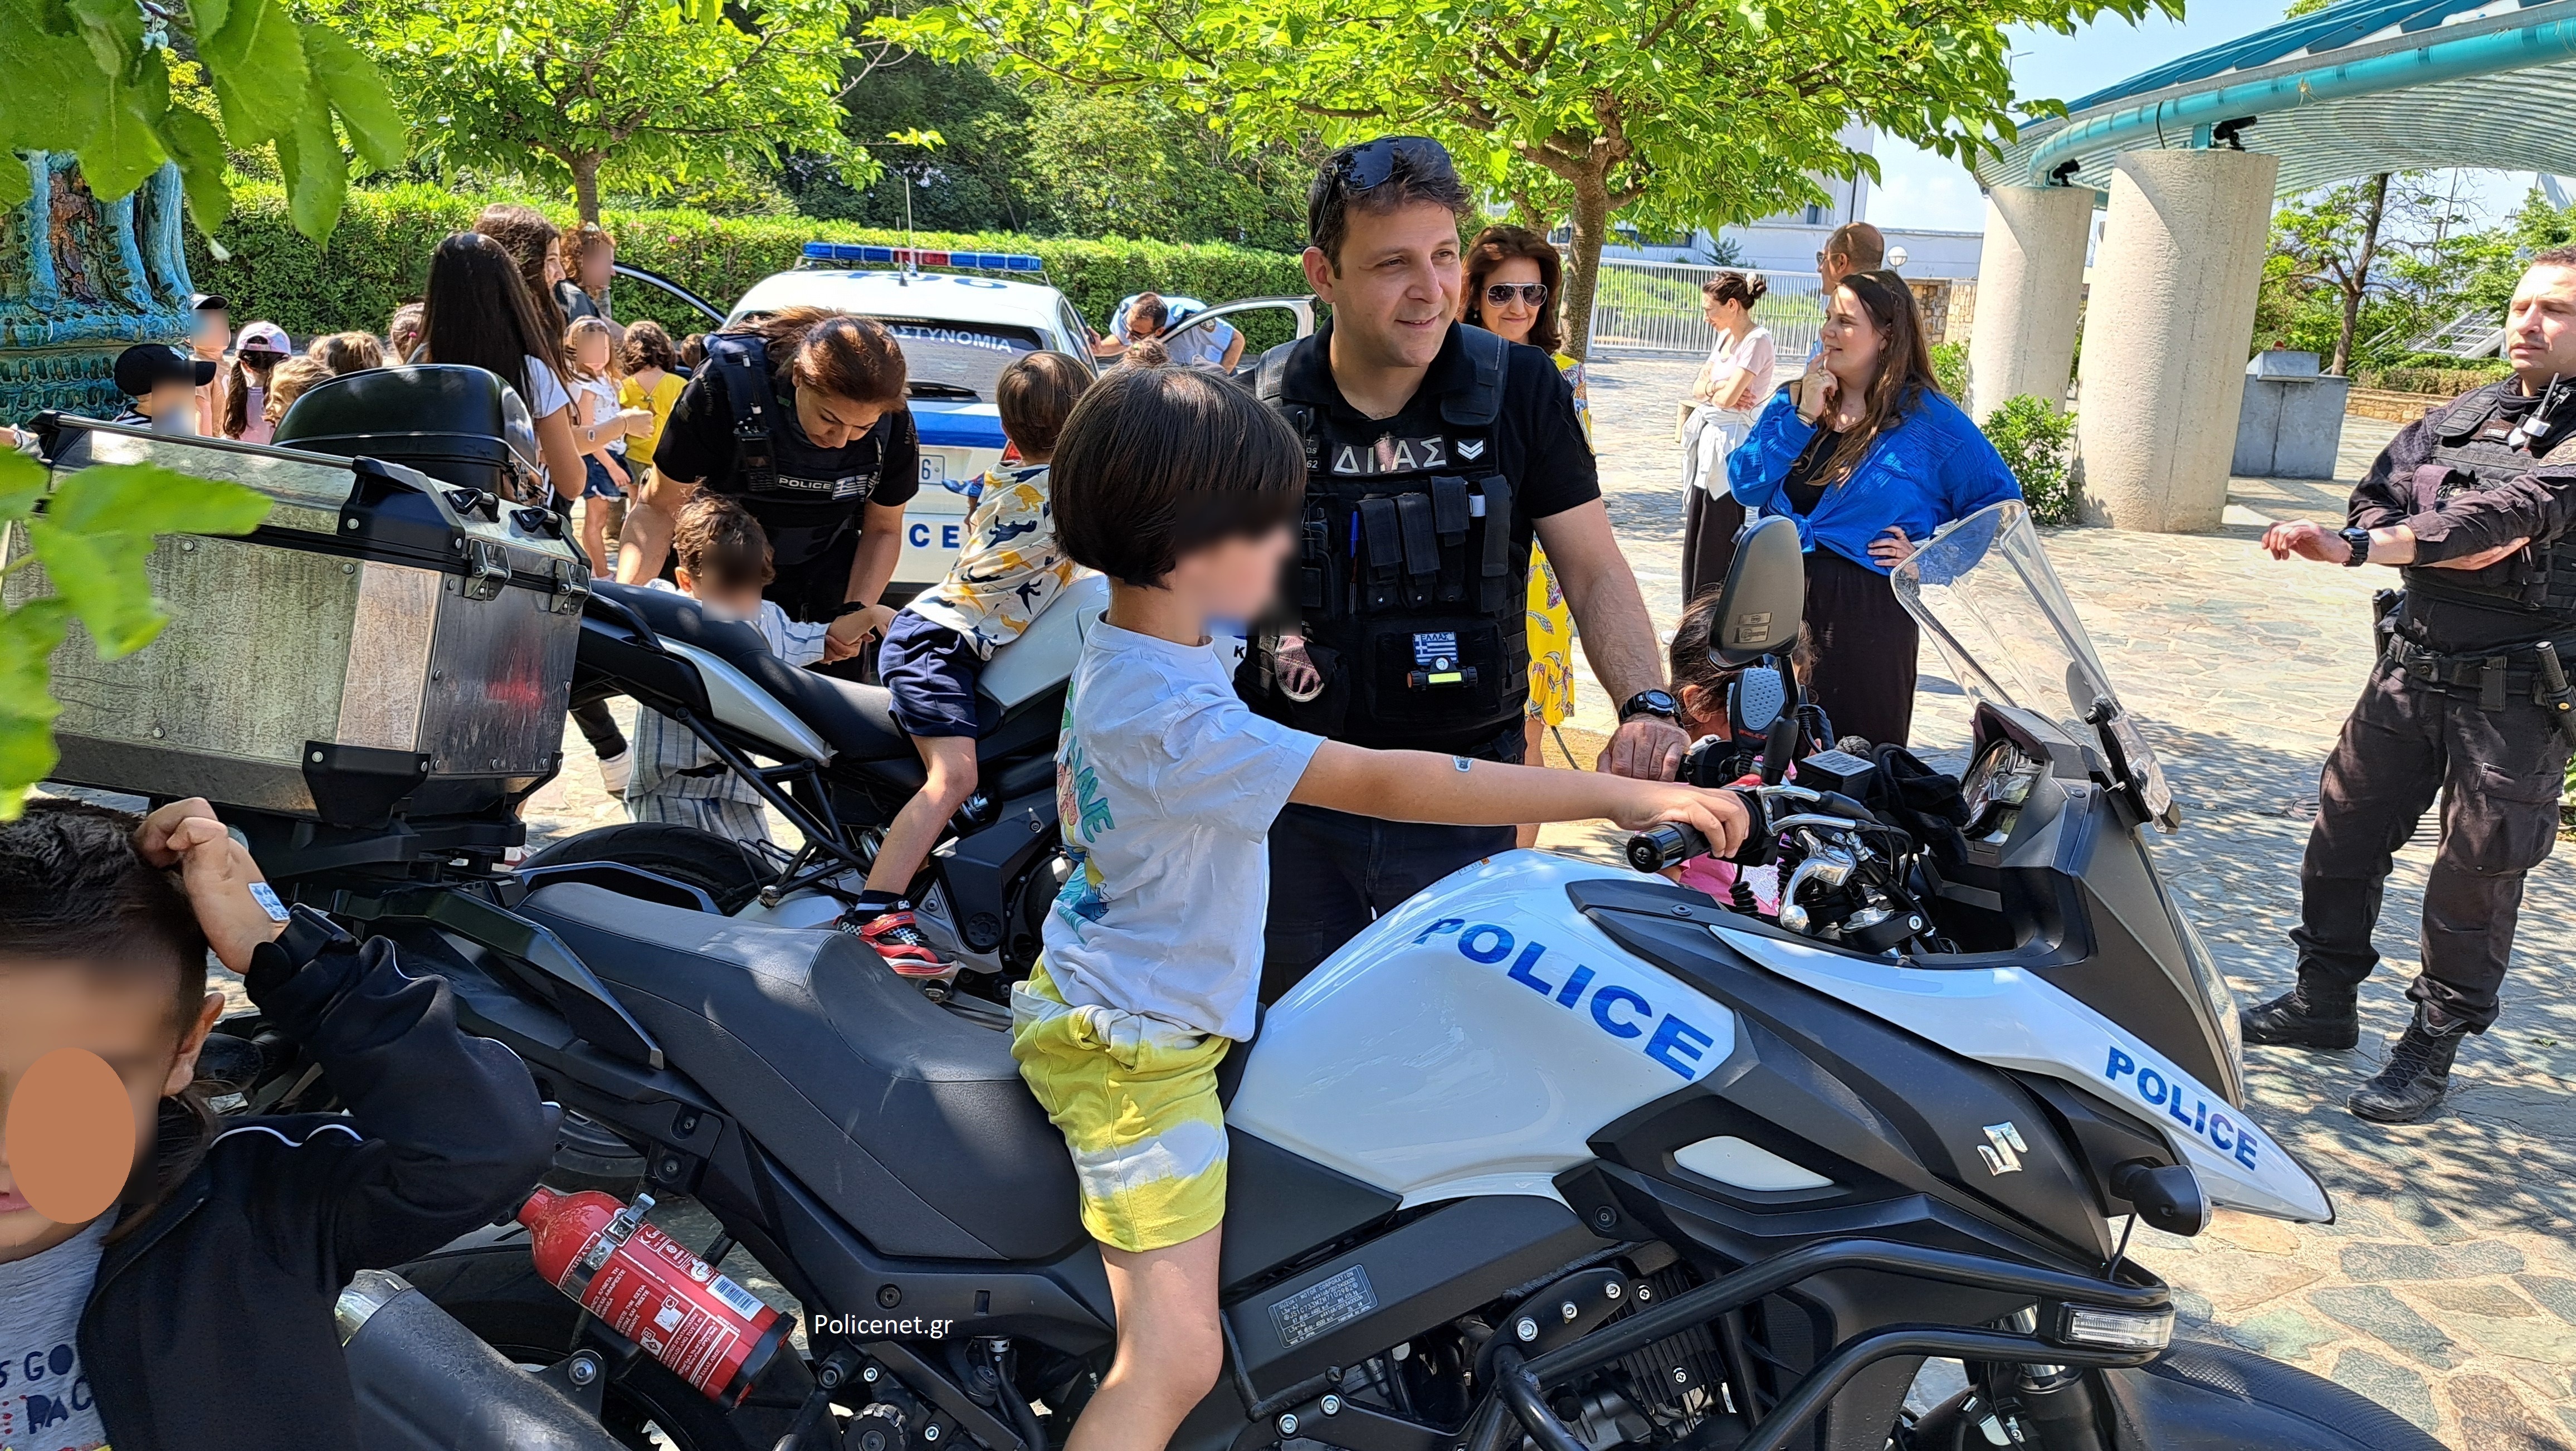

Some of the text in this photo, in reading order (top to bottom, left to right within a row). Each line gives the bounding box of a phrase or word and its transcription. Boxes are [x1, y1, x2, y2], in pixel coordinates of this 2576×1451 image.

[885, 324, 1013, 354] ΑΣΤΥΝΟΜΙΑ
[1334, 436, 1447, 474] ΔΙΑΣ
[779, 477, 832, 490] POLICE
[1411, 918, 1714, 1081] POLICE
[2105, 1045, 2258, 1171] POLICE
[1278, 1270, 1354, 1310] SUZUKI MOTOR CORPORATION
